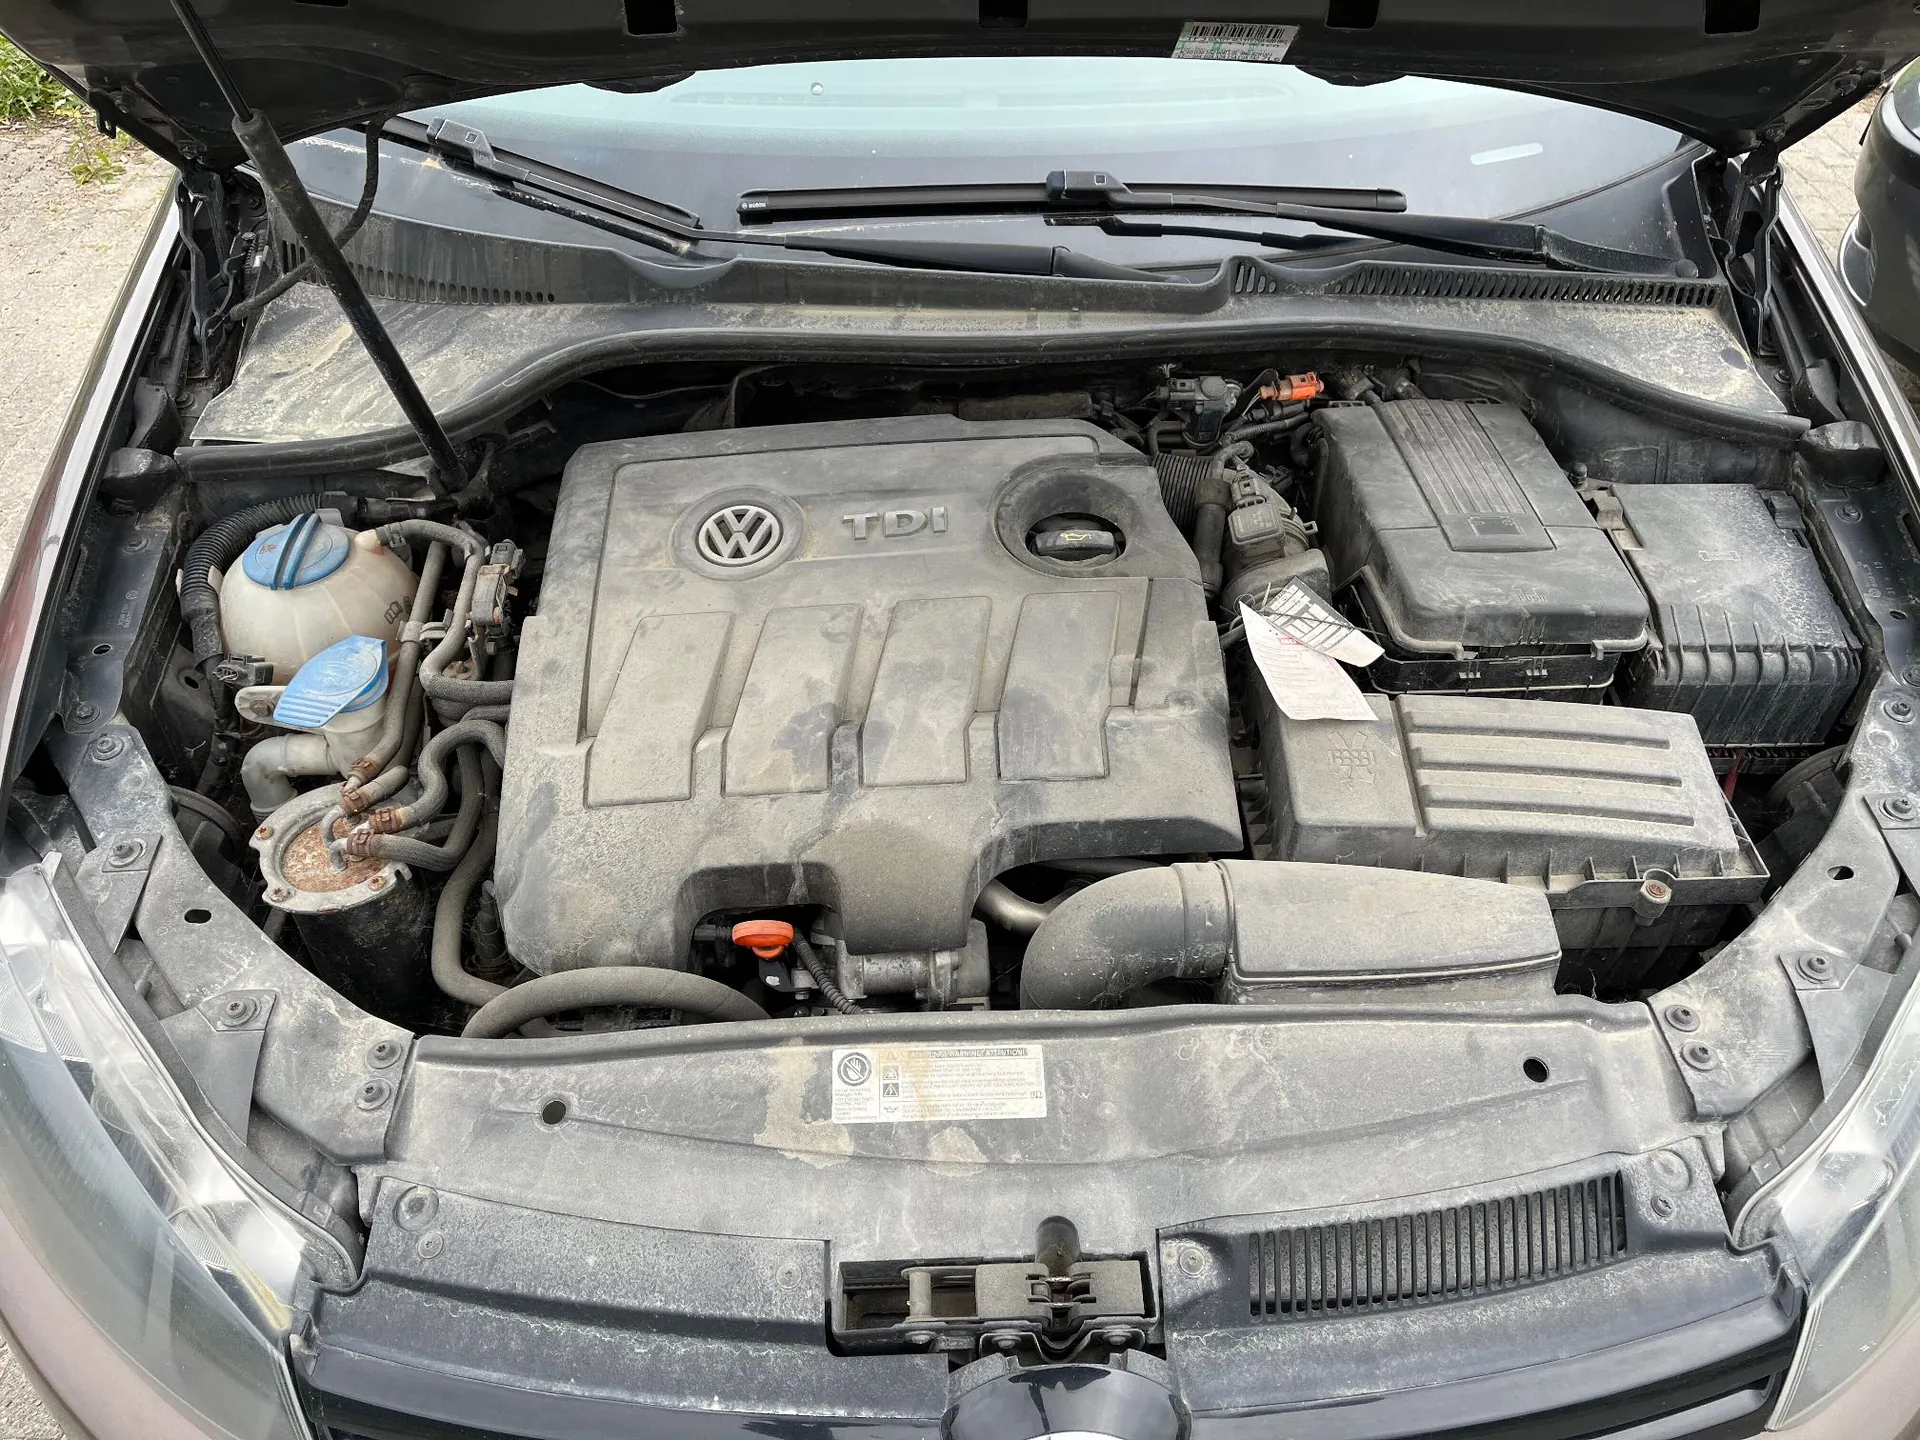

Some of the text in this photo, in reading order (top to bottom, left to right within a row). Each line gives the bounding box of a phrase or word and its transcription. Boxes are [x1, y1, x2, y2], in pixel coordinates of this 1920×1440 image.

[698, 505, 782, 565] VW
[841, 506, 948, 541] TDI
[984, 1048, 1026, 1056] ATTENTION!
